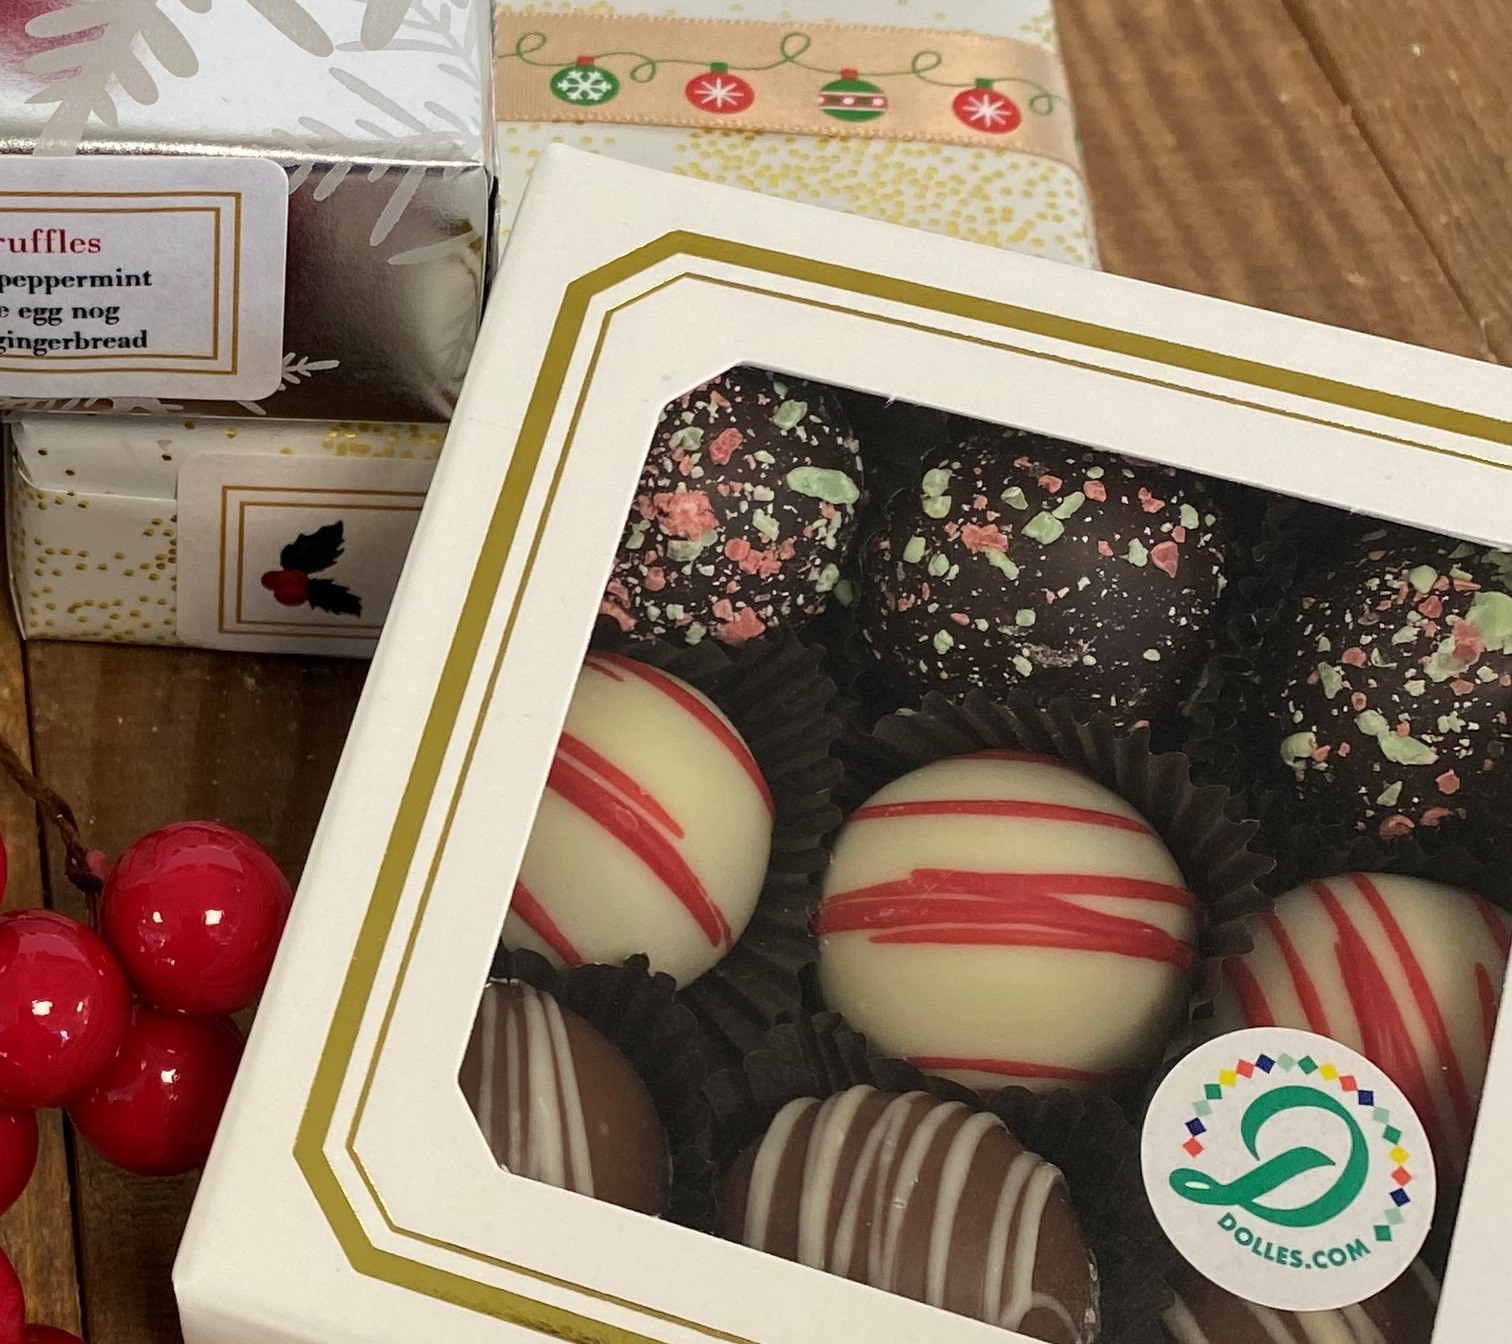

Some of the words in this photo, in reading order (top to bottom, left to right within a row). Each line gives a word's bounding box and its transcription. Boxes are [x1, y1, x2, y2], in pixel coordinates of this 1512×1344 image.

[18, 305, 63, 326] egg
[71, 305, 121, 325] nog
[1217, 1212, 1371, 1269] DOLLES.COM
